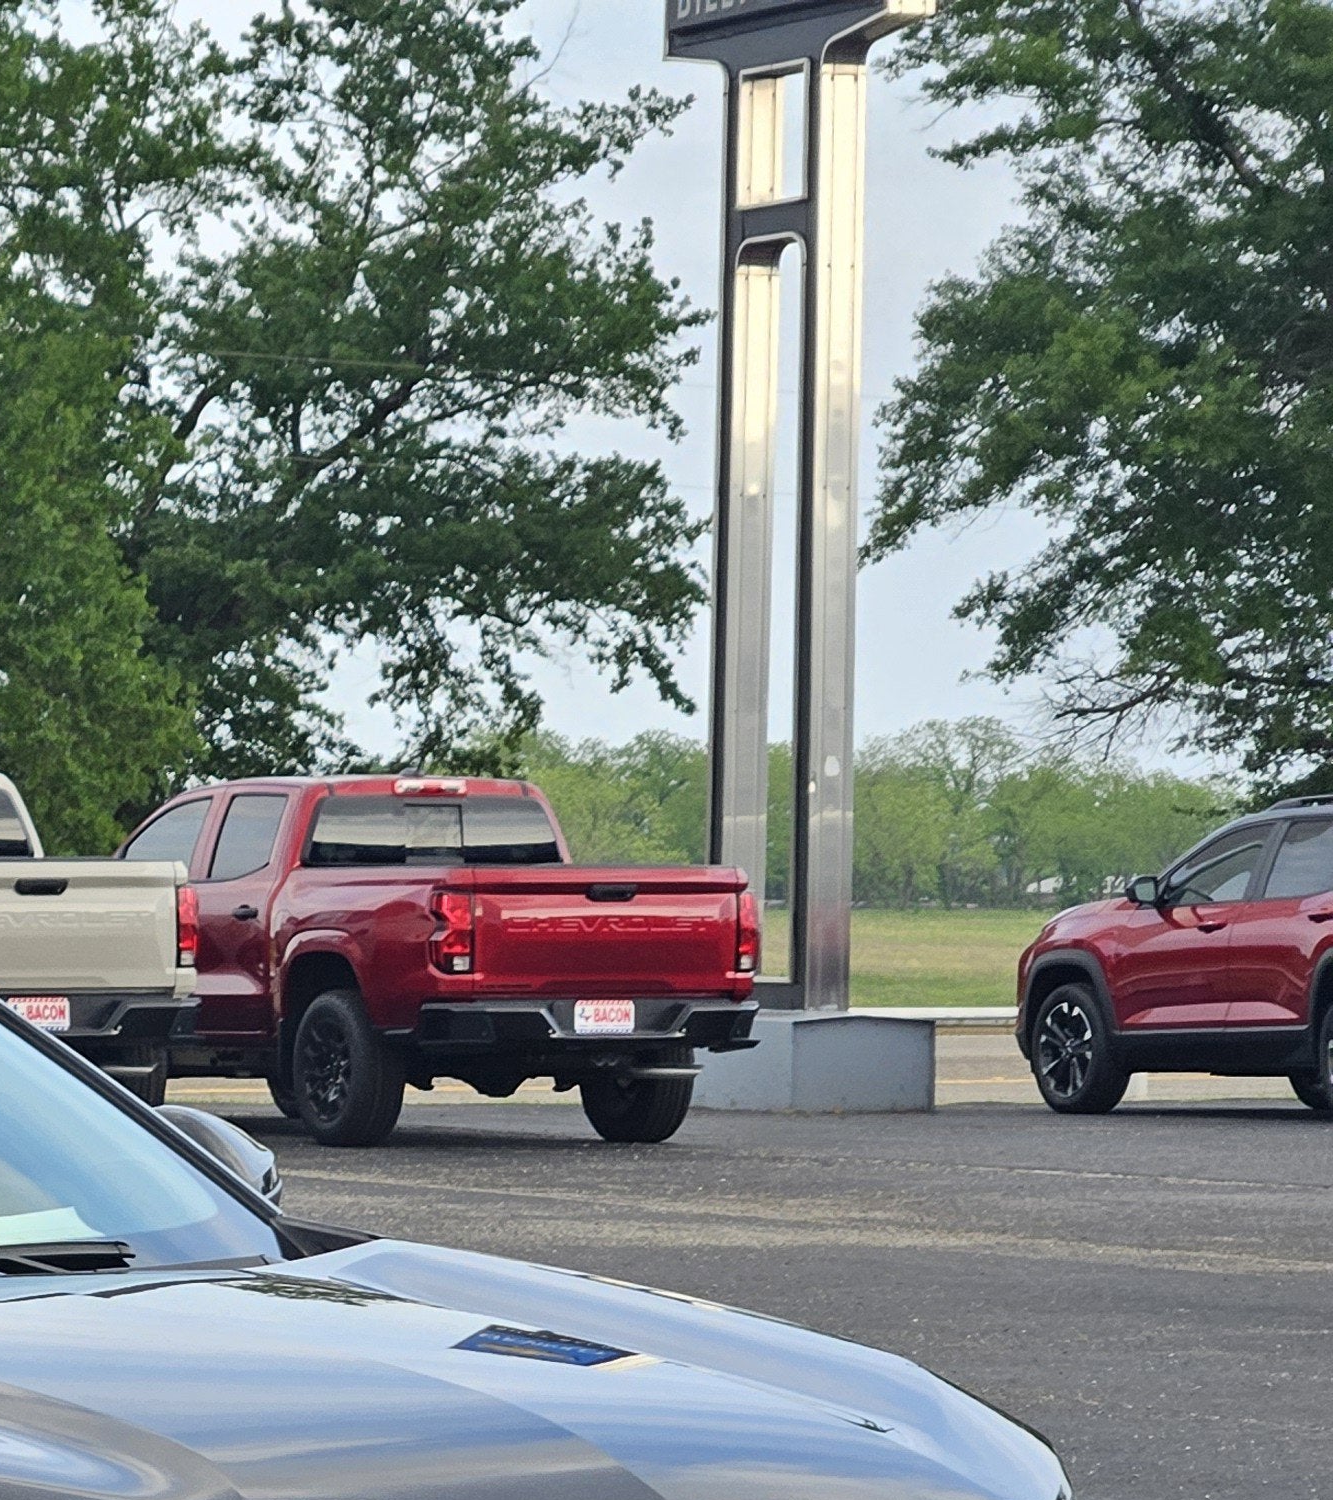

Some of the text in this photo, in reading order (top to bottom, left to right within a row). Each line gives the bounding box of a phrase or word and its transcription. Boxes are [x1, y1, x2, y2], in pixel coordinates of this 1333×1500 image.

[507, 917, 715, 933] CHEVROLET
[26, 1004, 66, 1020] BACON
[593, 1007, 630, 1022] BACON
